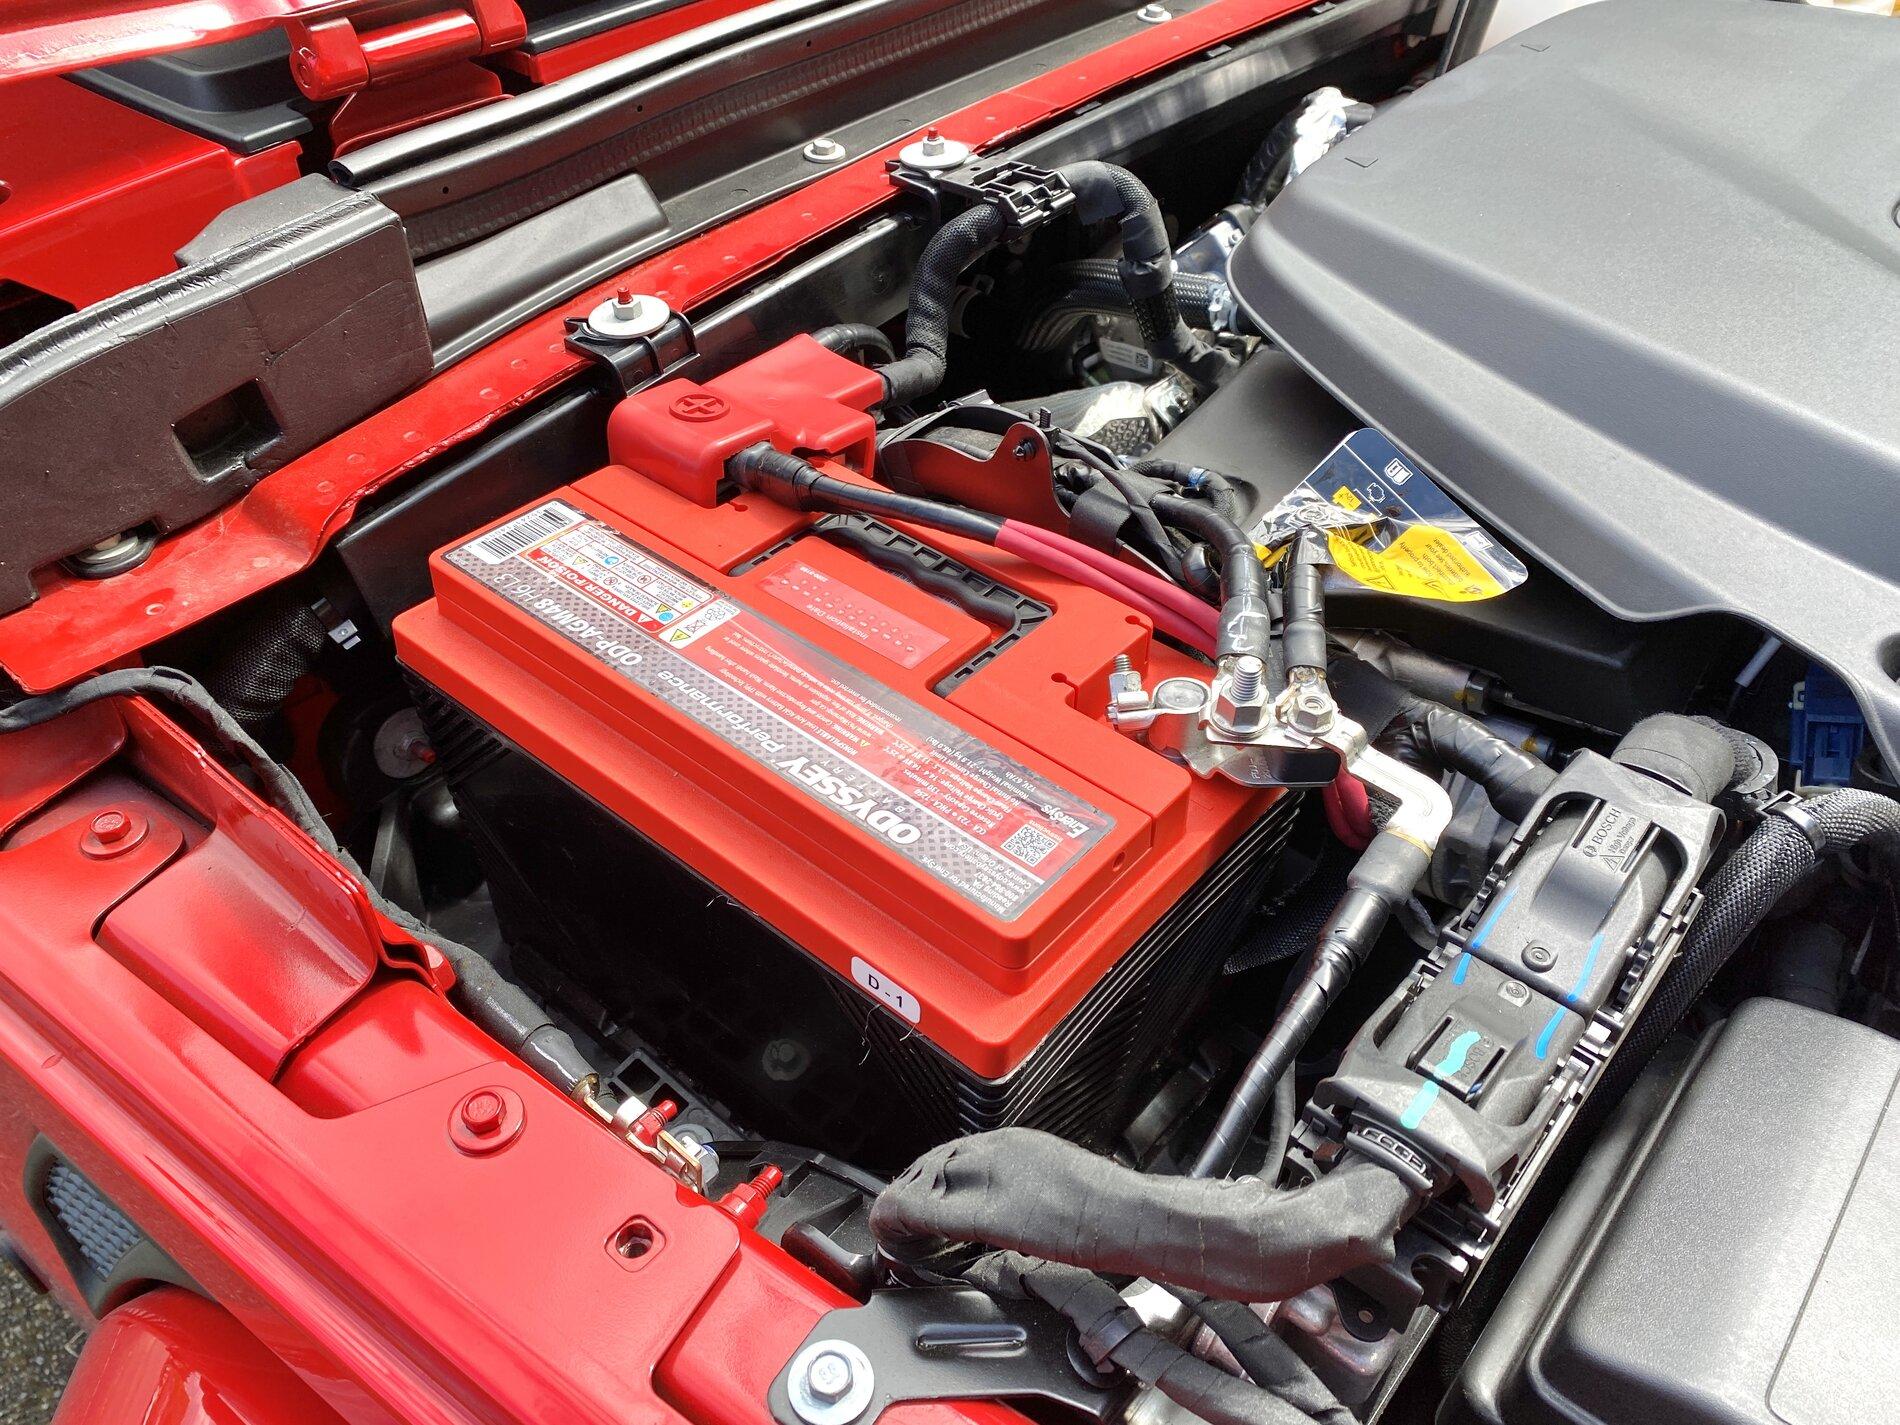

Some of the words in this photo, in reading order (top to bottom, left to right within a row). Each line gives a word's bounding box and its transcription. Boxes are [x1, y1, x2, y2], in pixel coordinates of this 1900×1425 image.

[1421, 552, 1434, 566] both
[491, 572, 521, 588] L3
[537, 554, 637, 616] DANGER/POISON
[509, 583, 543, 601] H6
[805, 601, 826, 617] Date
[530, 597, 644, 667] ODP-AGM48
[825, 612, 868, 641] Installation
[717, 667, 746, 685] Technology
[837, 682, 861, 697] inverted
[653, 670, 786, 753] Performance
[764, 695, 786, 710] Battery
[865, 699, 902, 722] recommended
[830, 722, 861, 742] WARNING:
[854, 715, 885, 735] WARNING:
[815, 728, 858, 755] NONSPILLABLE
[924, 734, 940, 745] lbs)
[935, 741, 956, 755] (48.0
[929, 749, 948, 762] Limit
[960, 756, 977, 768] 21.8
[944, 758, 971, 775] Current
[977, 766, 1003, 783] Weight
[819, 758, 906, 811] BATTERY
[901, 768, 930, 787] minutes
[967, 772, 992, 788] Charge
[1003, 771, 1023, 783] 67Ah
[1021, 780, 1037, 792] 12V,
[936, 777, 966, 797] Voltage:
[971, 786, 997, 803] Charge
[989, 785, 1012, 800] Initial
[998, 779, 1029, 799] Nominal
[775, 754, 925, 843] ODYSSEY
[941, 792, 971, 812] Capacity
[962, 793, 987, 810] Charge
[967, 809, 996, 827] Reserve
[984, 806, 1005, 820] Cyclic
[1040, 804, 1089, 838] EnerSys
[1028, 819, 1063, 842] Instructions
[1592, 808, 1622, 846] BOSCH
[955, 839, 973, 852] USA
[971, 848, 997, 867] Origin:
[942, 839, 1027, 895] www.odysseybattery.com
[971, 879, 984, 889] PA
[1002, 868, 1033, 889] Country
[957, 880, 1006, 913] Manufactured
[981, 885, 1014, 907] Reading
